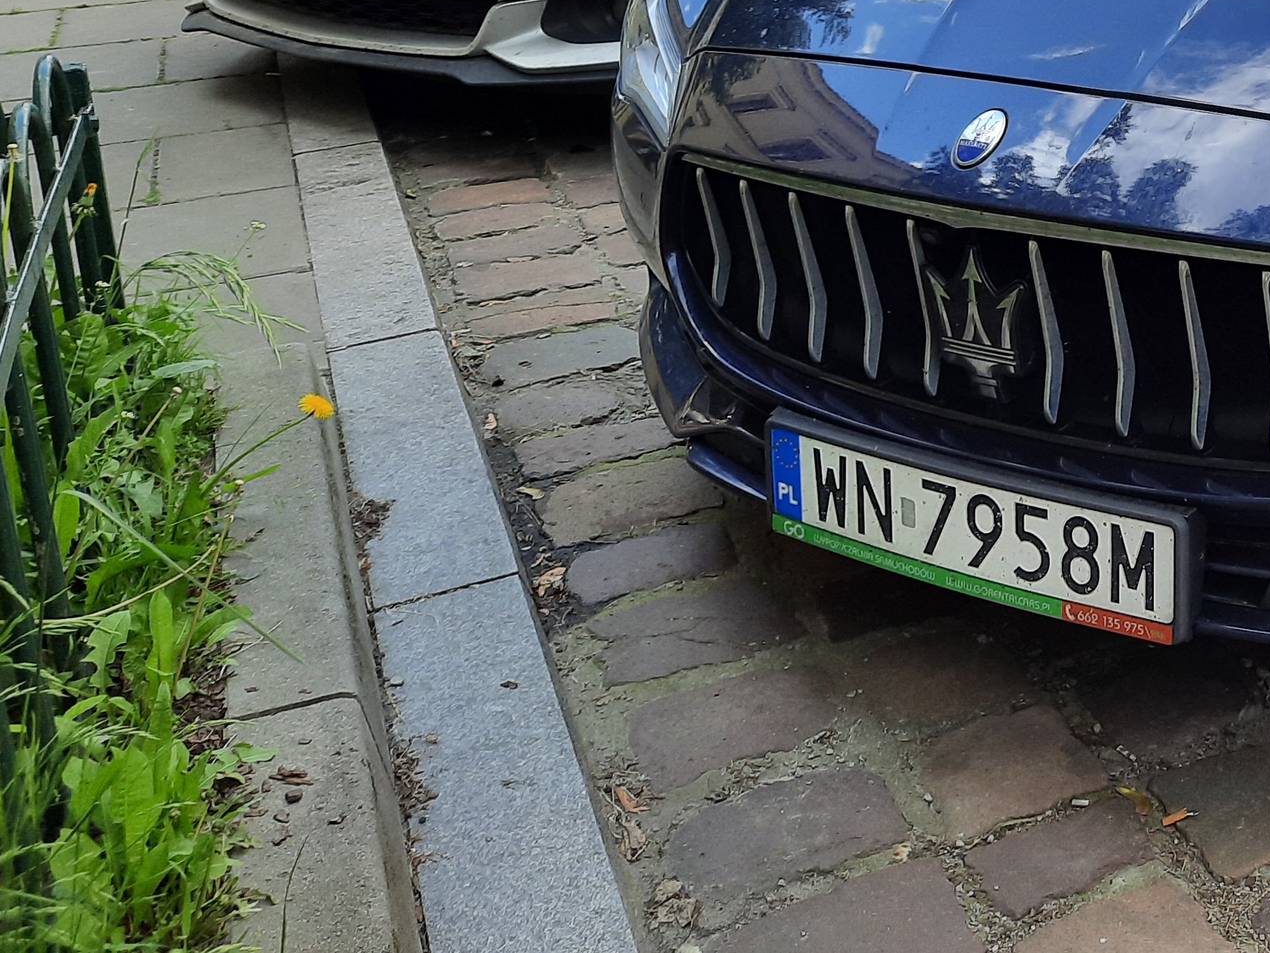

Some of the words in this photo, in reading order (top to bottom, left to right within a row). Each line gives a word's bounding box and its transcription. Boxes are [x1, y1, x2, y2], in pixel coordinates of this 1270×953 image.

[777, 482, 799, 506] PL
[783, 520, 805, 540] GO
[813, 447, 893, 544] WN
[921, 478, 1155, 612] 7958M
[1077, 609, 1099, 625] 662
[1102, 615, 1120, 630] 135
[1123, 621, 1145, 636] 975
